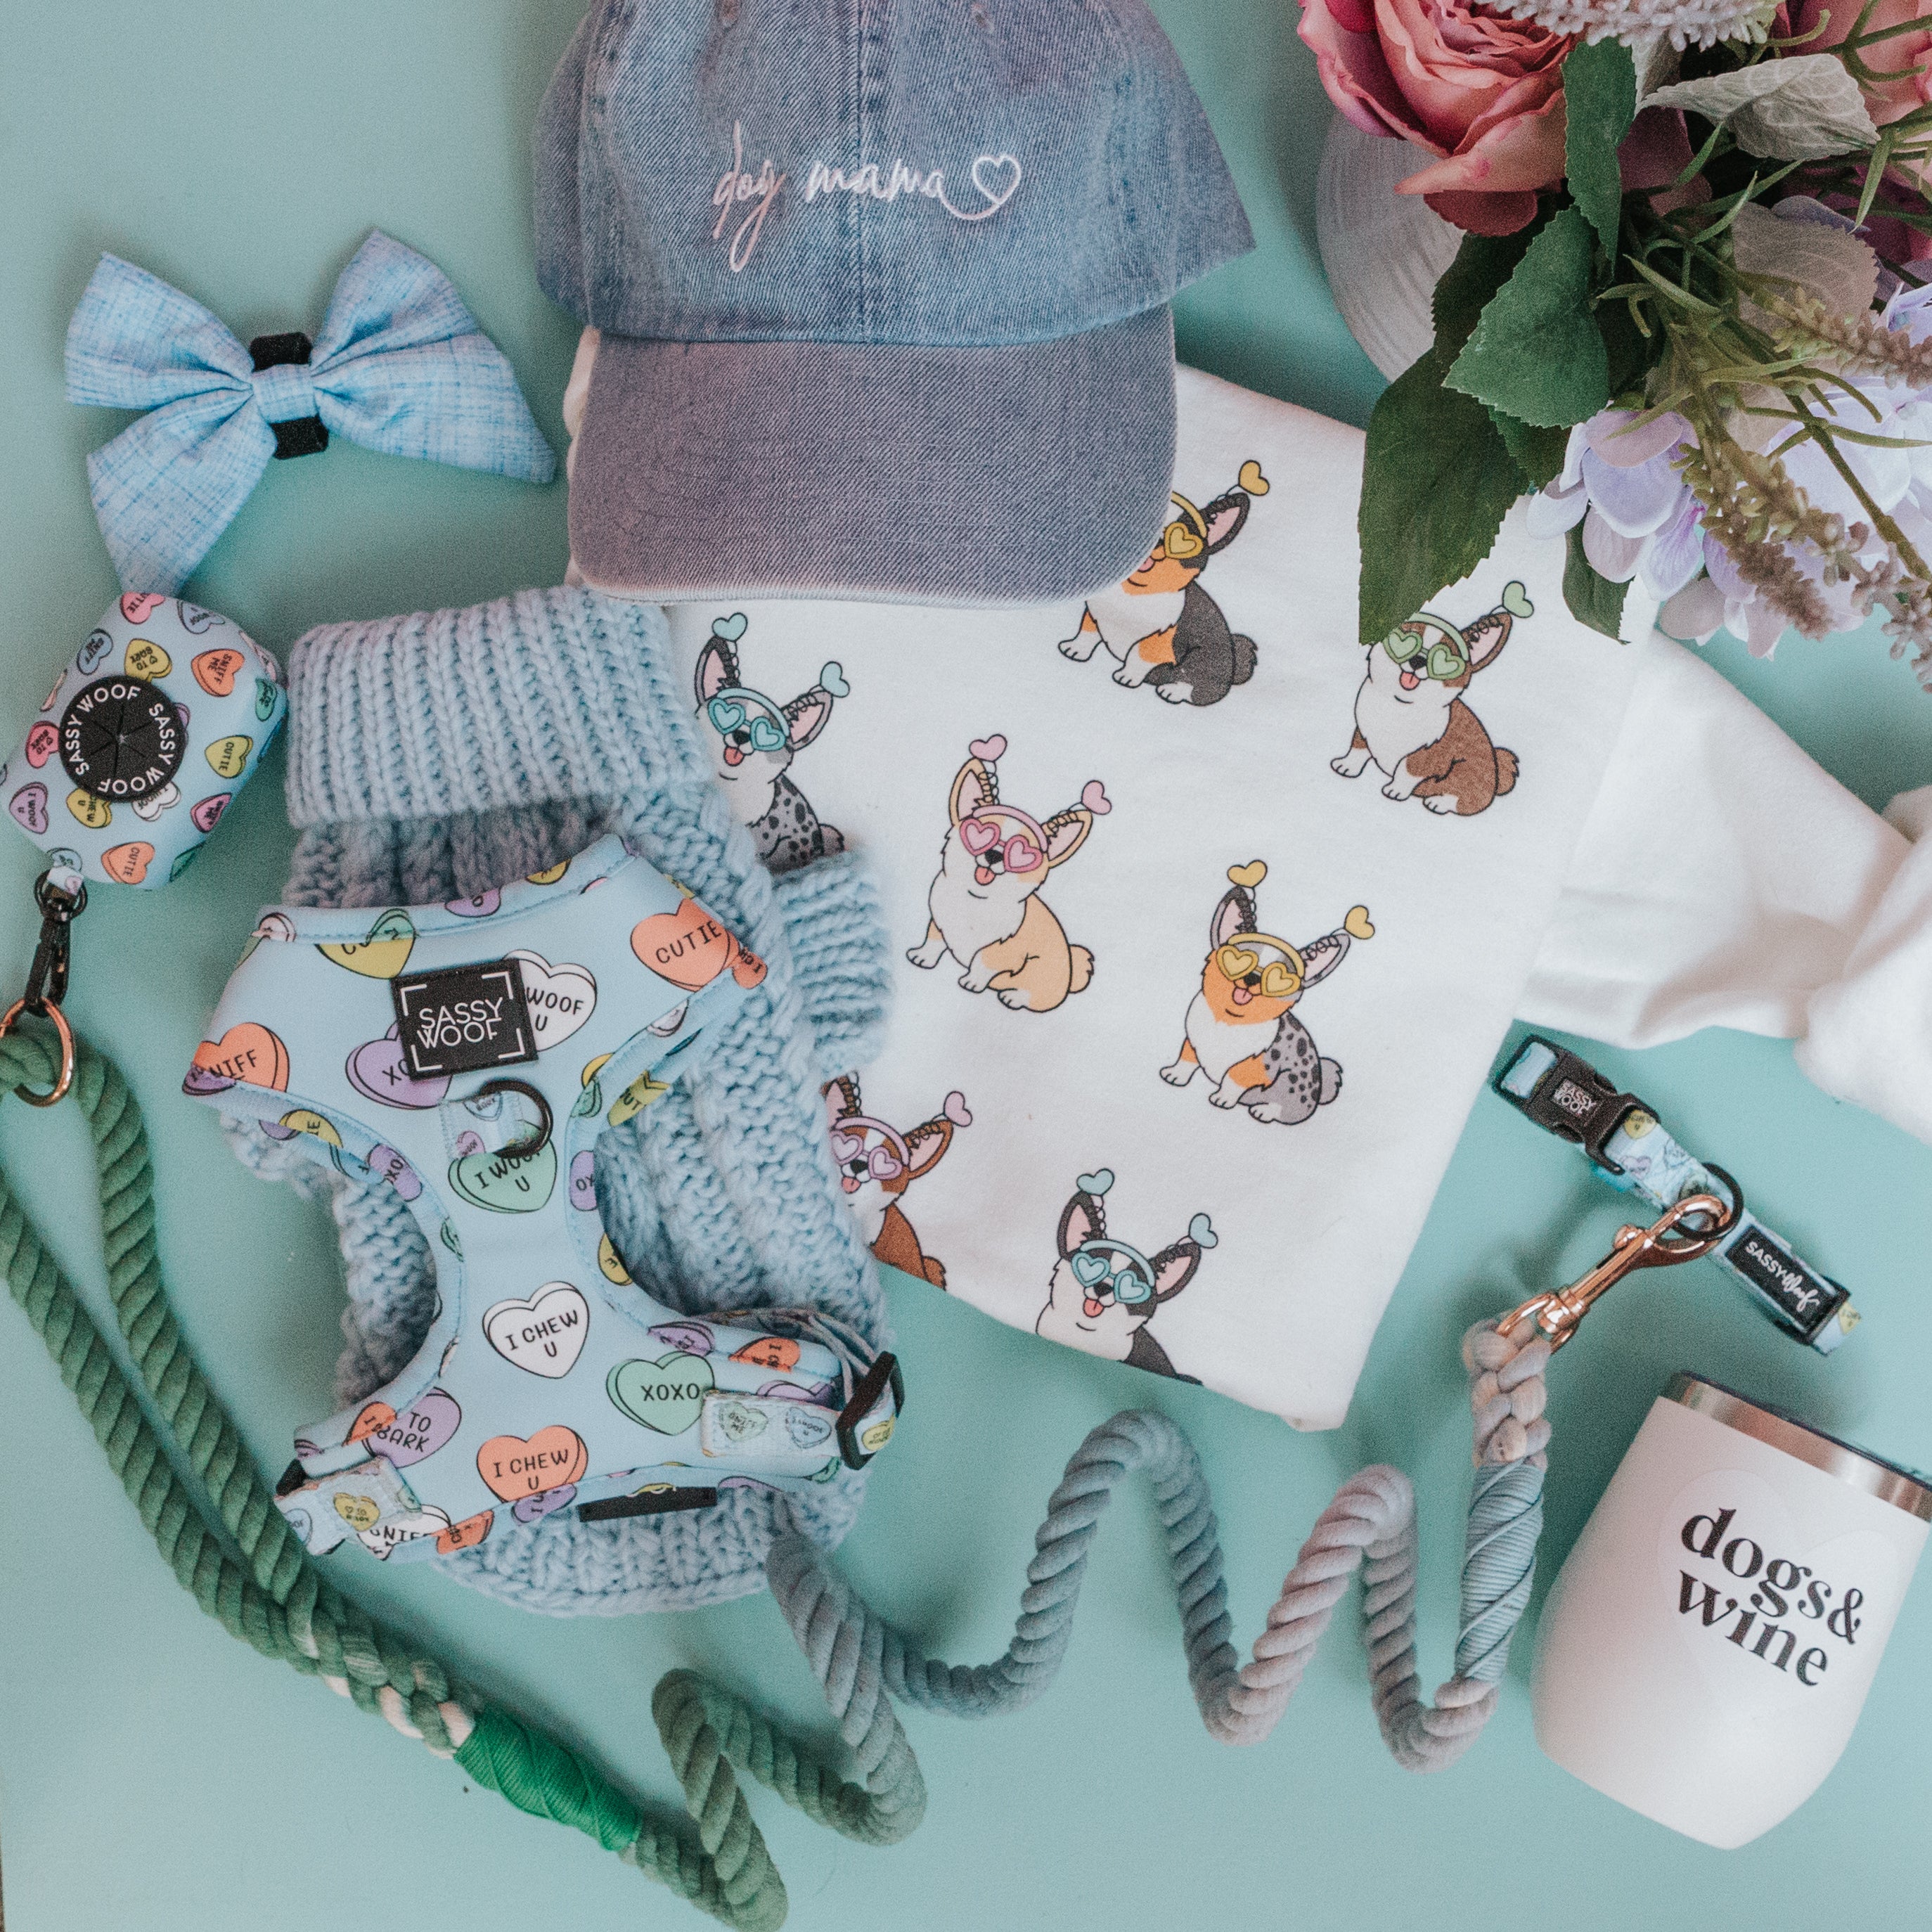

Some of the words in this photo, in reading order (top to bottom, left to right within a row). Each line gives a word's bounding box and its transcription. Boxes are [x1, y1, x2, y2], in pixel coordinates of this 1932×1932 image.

[712, 120, 786, 272] dog
[806, 159, 945, 202] mama
[214, 653, 232, 685] SNIFF
[77, 683, 141, 714] WOOF
[65, 714, 90, 775] SASSY
[148, 703, 176, 766] SASSY
[218, 741, 235, 772] CUTIE
[97, 766, 165, 794] WOOF
[122, 846, 141, 877] CUTIE
[655, 920, 722, 964] CUTIE
[419, 997, 503, 1030] SASSY
[527, 986, 584, 1015] WOOF
[417, 1017, 502, 1049] WOOF
[535, 1013, 548, 1032] U
[1560, 1080, 1597, 1112] SASSY
[475, 1171, 489, 1189] I
[515, 1176, 530, 1192] U
[505, 1334, 518, 1351] I
[522, 1309, 579, 1344] CHEW
[544, 1341, 557, 1358] U
[640, 1382, 700, 1402] XOXO
[410, 1411, 431, 1433] TO
[377, 1424, 430, 1453] BARK
[494, 1462, 501, 1478] I
[510, 1449, 568, 1474] CHEW
[527, 1476, 539, 1490] U
[1678, 1569, 1829, 1687] wine
